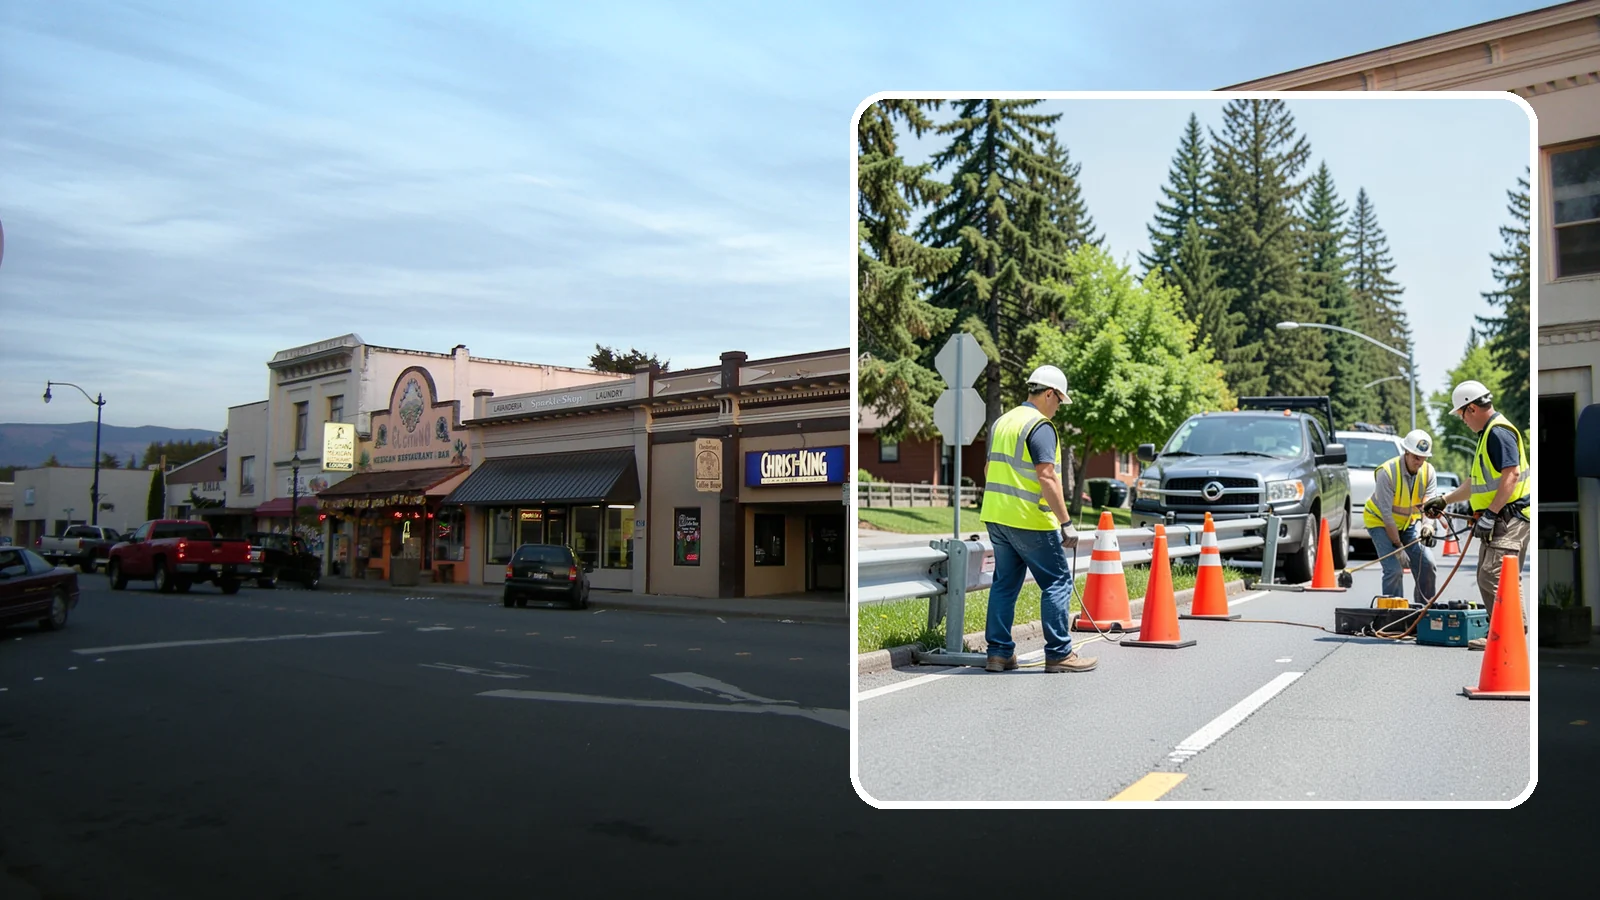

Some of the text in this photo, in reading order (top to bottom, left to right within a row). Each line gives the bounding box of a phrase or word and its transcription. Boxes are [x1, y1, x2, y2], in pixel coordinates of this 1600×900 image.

[493, 389, 624, 413] LAVANDERIA Sparkle Shop LAUNDRY
[373, 455, 396, 464] MEXICAN
[397, 451, 434, 462] RESTAURANT
[438, 450, 450, 459] BAR
[761, 450, 827, 478] CHRIST KING
